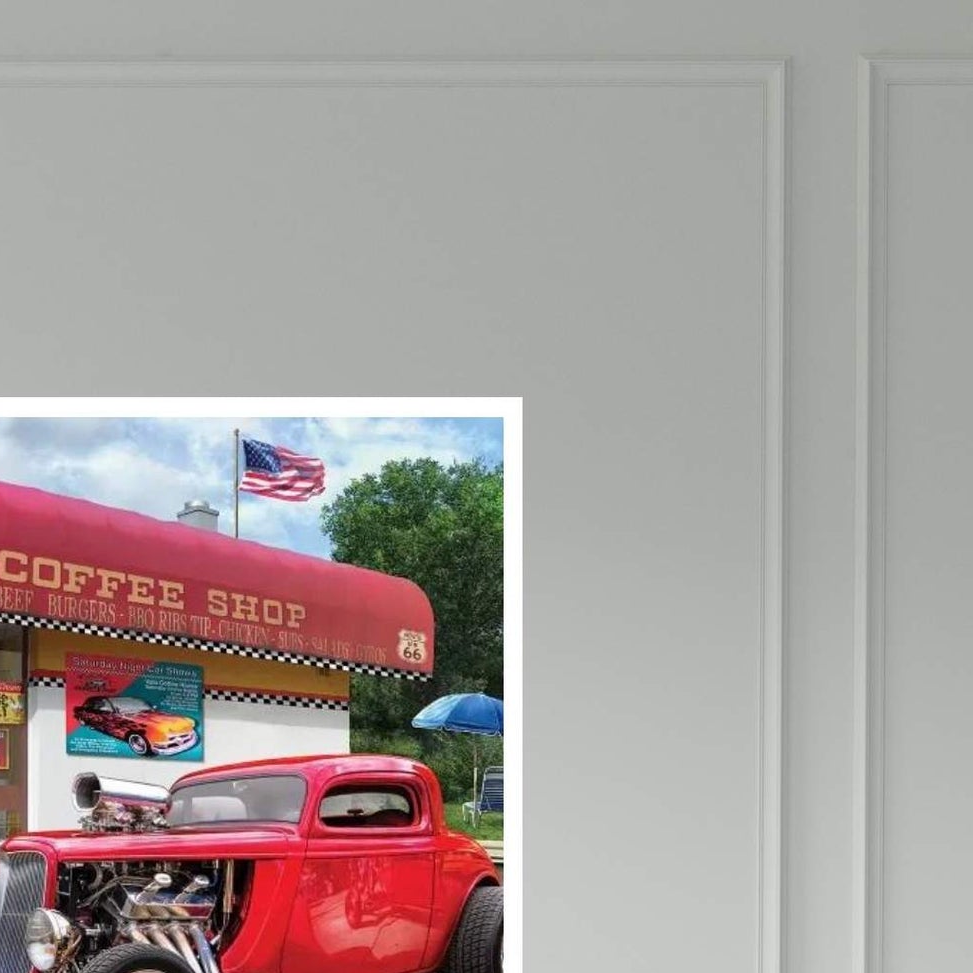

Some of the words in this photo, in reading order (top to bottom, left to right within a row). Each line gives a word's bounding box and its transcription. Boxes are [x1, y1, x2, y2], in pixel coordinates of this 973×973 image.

[47, 593, 117, 624] BURGERS
[129, 606, 155, 630] BBQ
[158, 610, 188, 634] RIBS
[218, 619, 271, 647] CHICKEN
[207, 588, 307, 629] SHOP
[403, 646, 423, 661] 66
